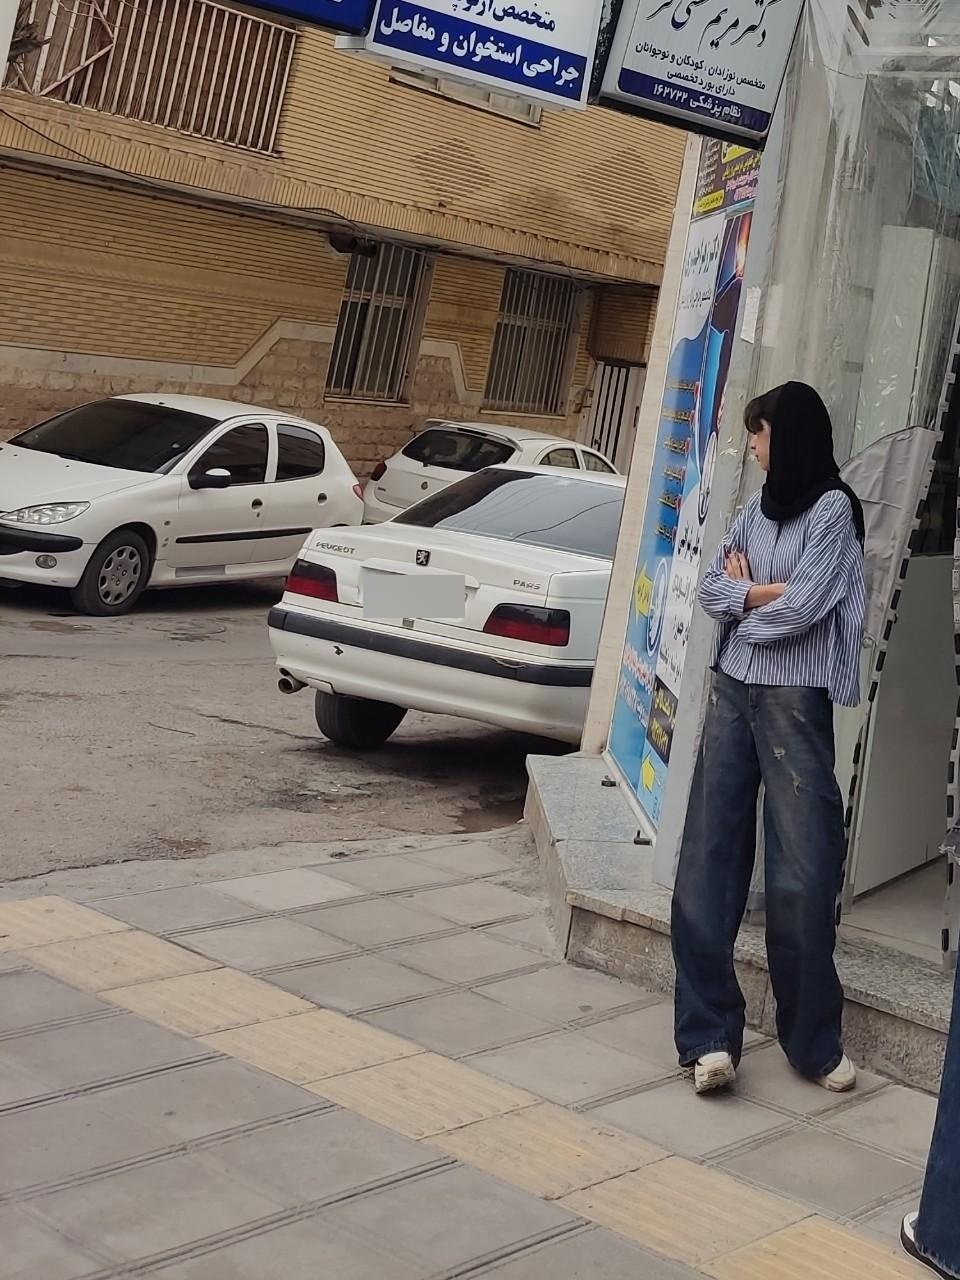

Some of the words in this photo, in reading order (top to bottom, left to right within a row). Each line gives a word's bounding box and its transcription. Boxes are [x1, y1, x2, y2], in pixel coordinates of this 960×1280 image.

[380, 7, 436, 41] مفاصل
[492, 2, 556, 32] متخصص
[697, 7, 740, 54] مریم
[437, 31, 450, 53] و
[452, 31, 522, 66] استخوان
[635, 41, 670, 61] نوجوانان
[676, 53, 705, 71] کودکان
[522, 56, 580, 88] جراحی
[667, 70, 698, 84] تخصصی
[698, 77, 715, 91] بورد
[715, 82, 736, 97] دارای
[736, 74, 766, 90] متخصص
[689, 96, 723, 118] پزشکی
[722, 105, 741, 118] نظام
[315, 541, 356, 555] PEUGEOT
[512, 579, 542, 590] PARS
